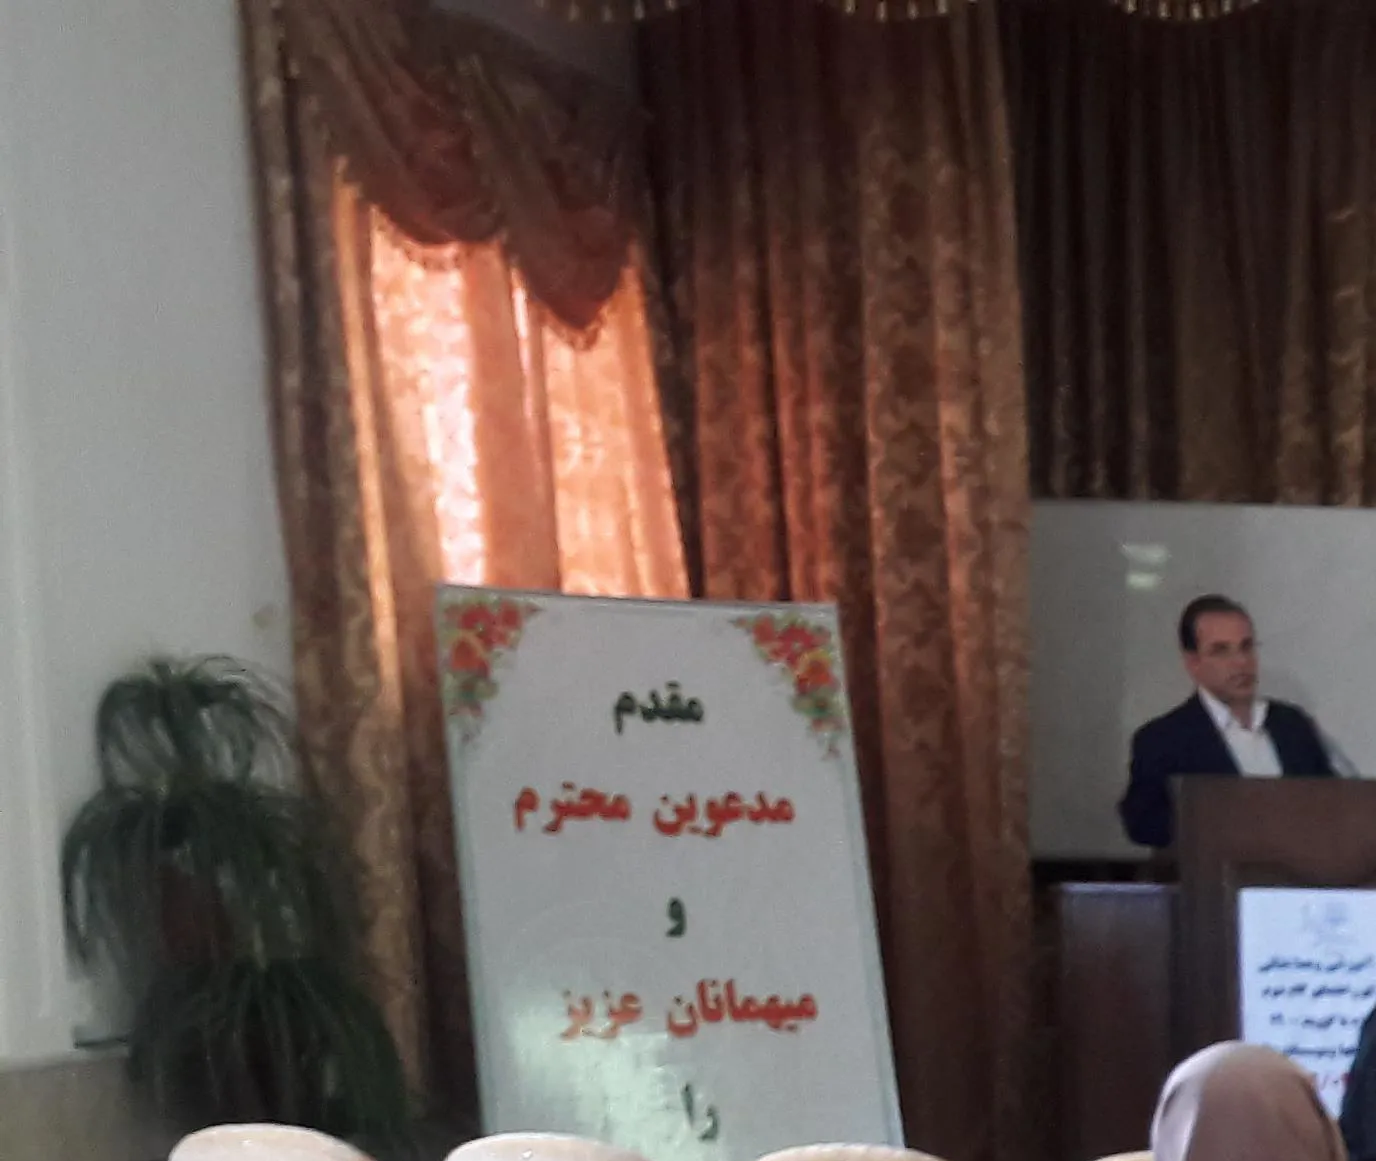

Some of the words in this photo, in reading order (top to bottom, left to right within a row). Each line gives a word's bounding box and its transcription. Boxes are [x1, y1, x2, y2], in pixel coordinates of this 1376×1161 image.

[613, 682, 705, 734] مقدم
[513, 780, 632, 834] محترم
[652, 785, 795, 837] مدعوین
[666, 897, 687, 937] و
[559, 987, 643, 1040] عزیز
[666, 979, 819, 1038] میهمانان
